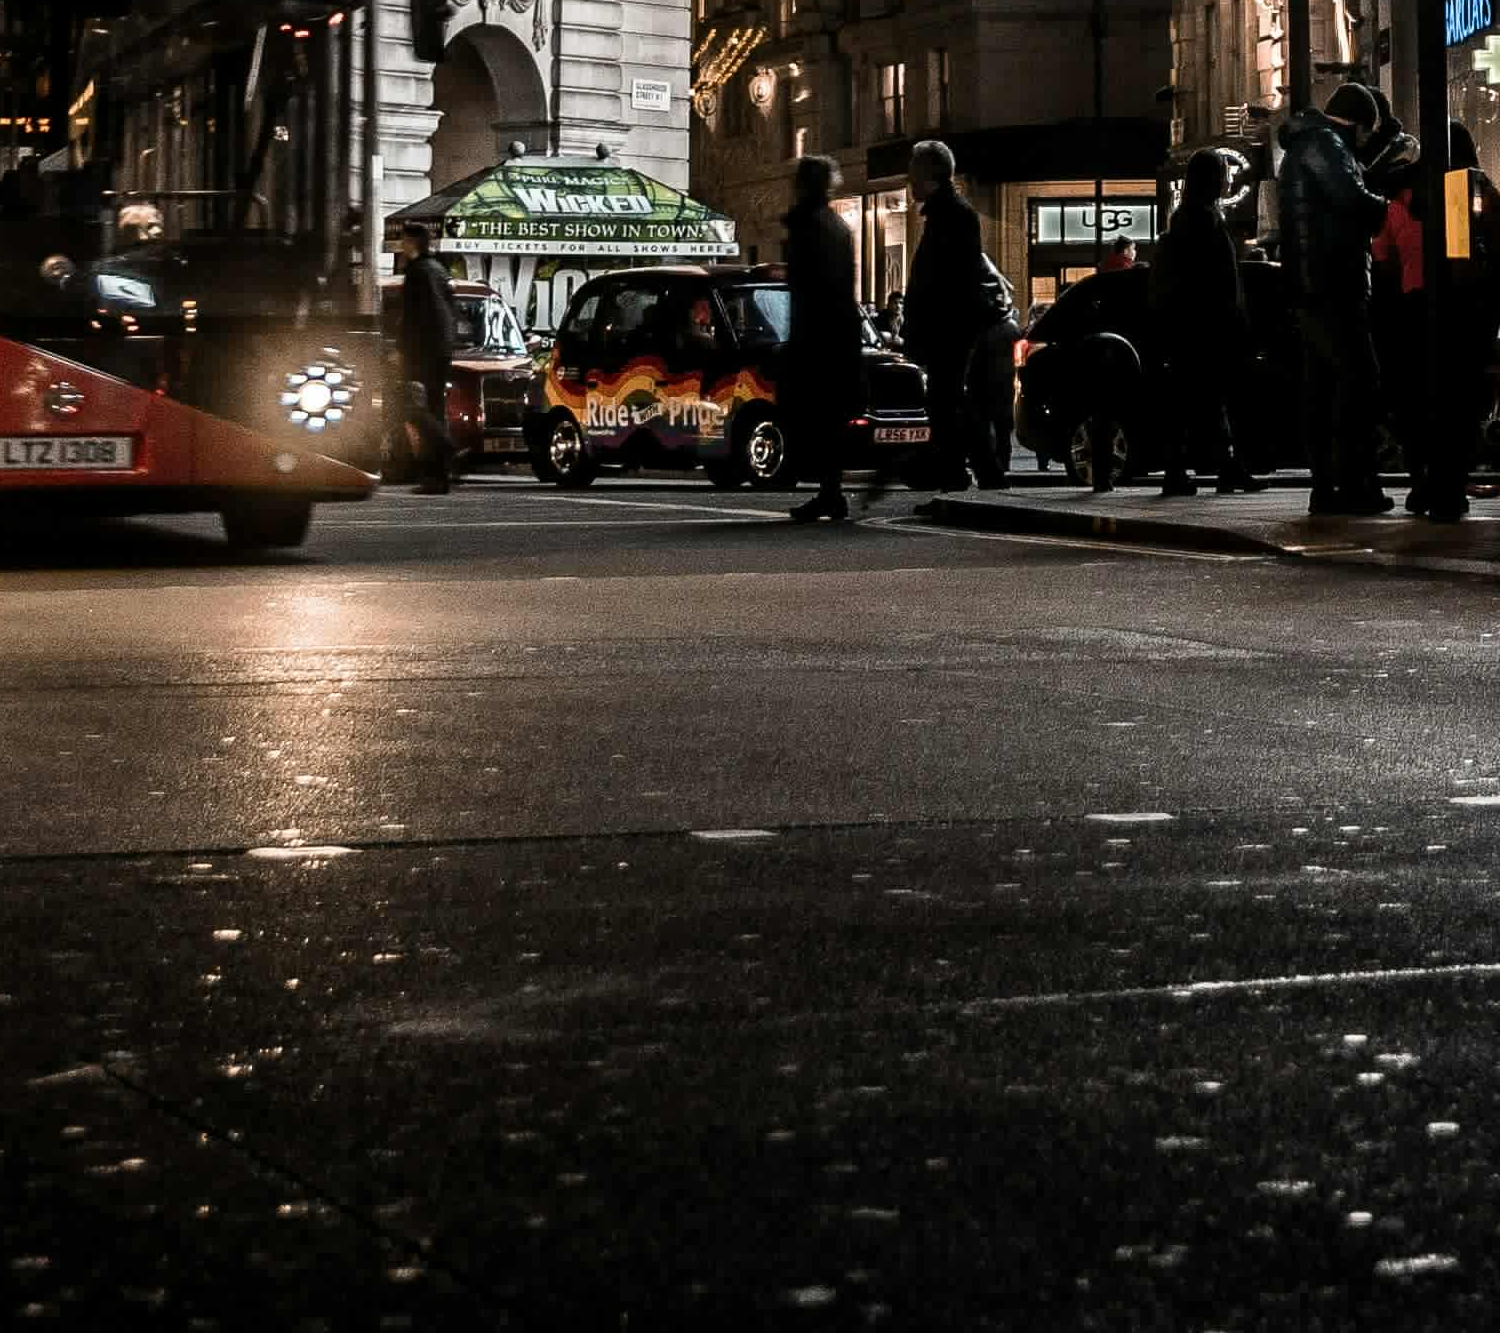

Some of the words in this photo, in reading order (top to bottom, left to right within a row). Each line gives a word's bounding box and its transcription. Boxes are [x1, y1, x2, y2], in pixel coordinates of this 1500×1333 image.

[518, 222, 561, 238] BEST
[564, 222, 621, 238] SHOW
[622, 223, 642, 238] IN
[455, 241, 481, 249] BUY
[493, 242, 548, 251] TICKETS
[561, 243, 586, 252] FOR
[599, 244, 621, 253] ALL
[633, 244, 678, 253] SHOWS
[690, 245, 722, 253] HERE
[587, 396, 629, 428] Ride
[3, 440, 52, 464] LTZ
